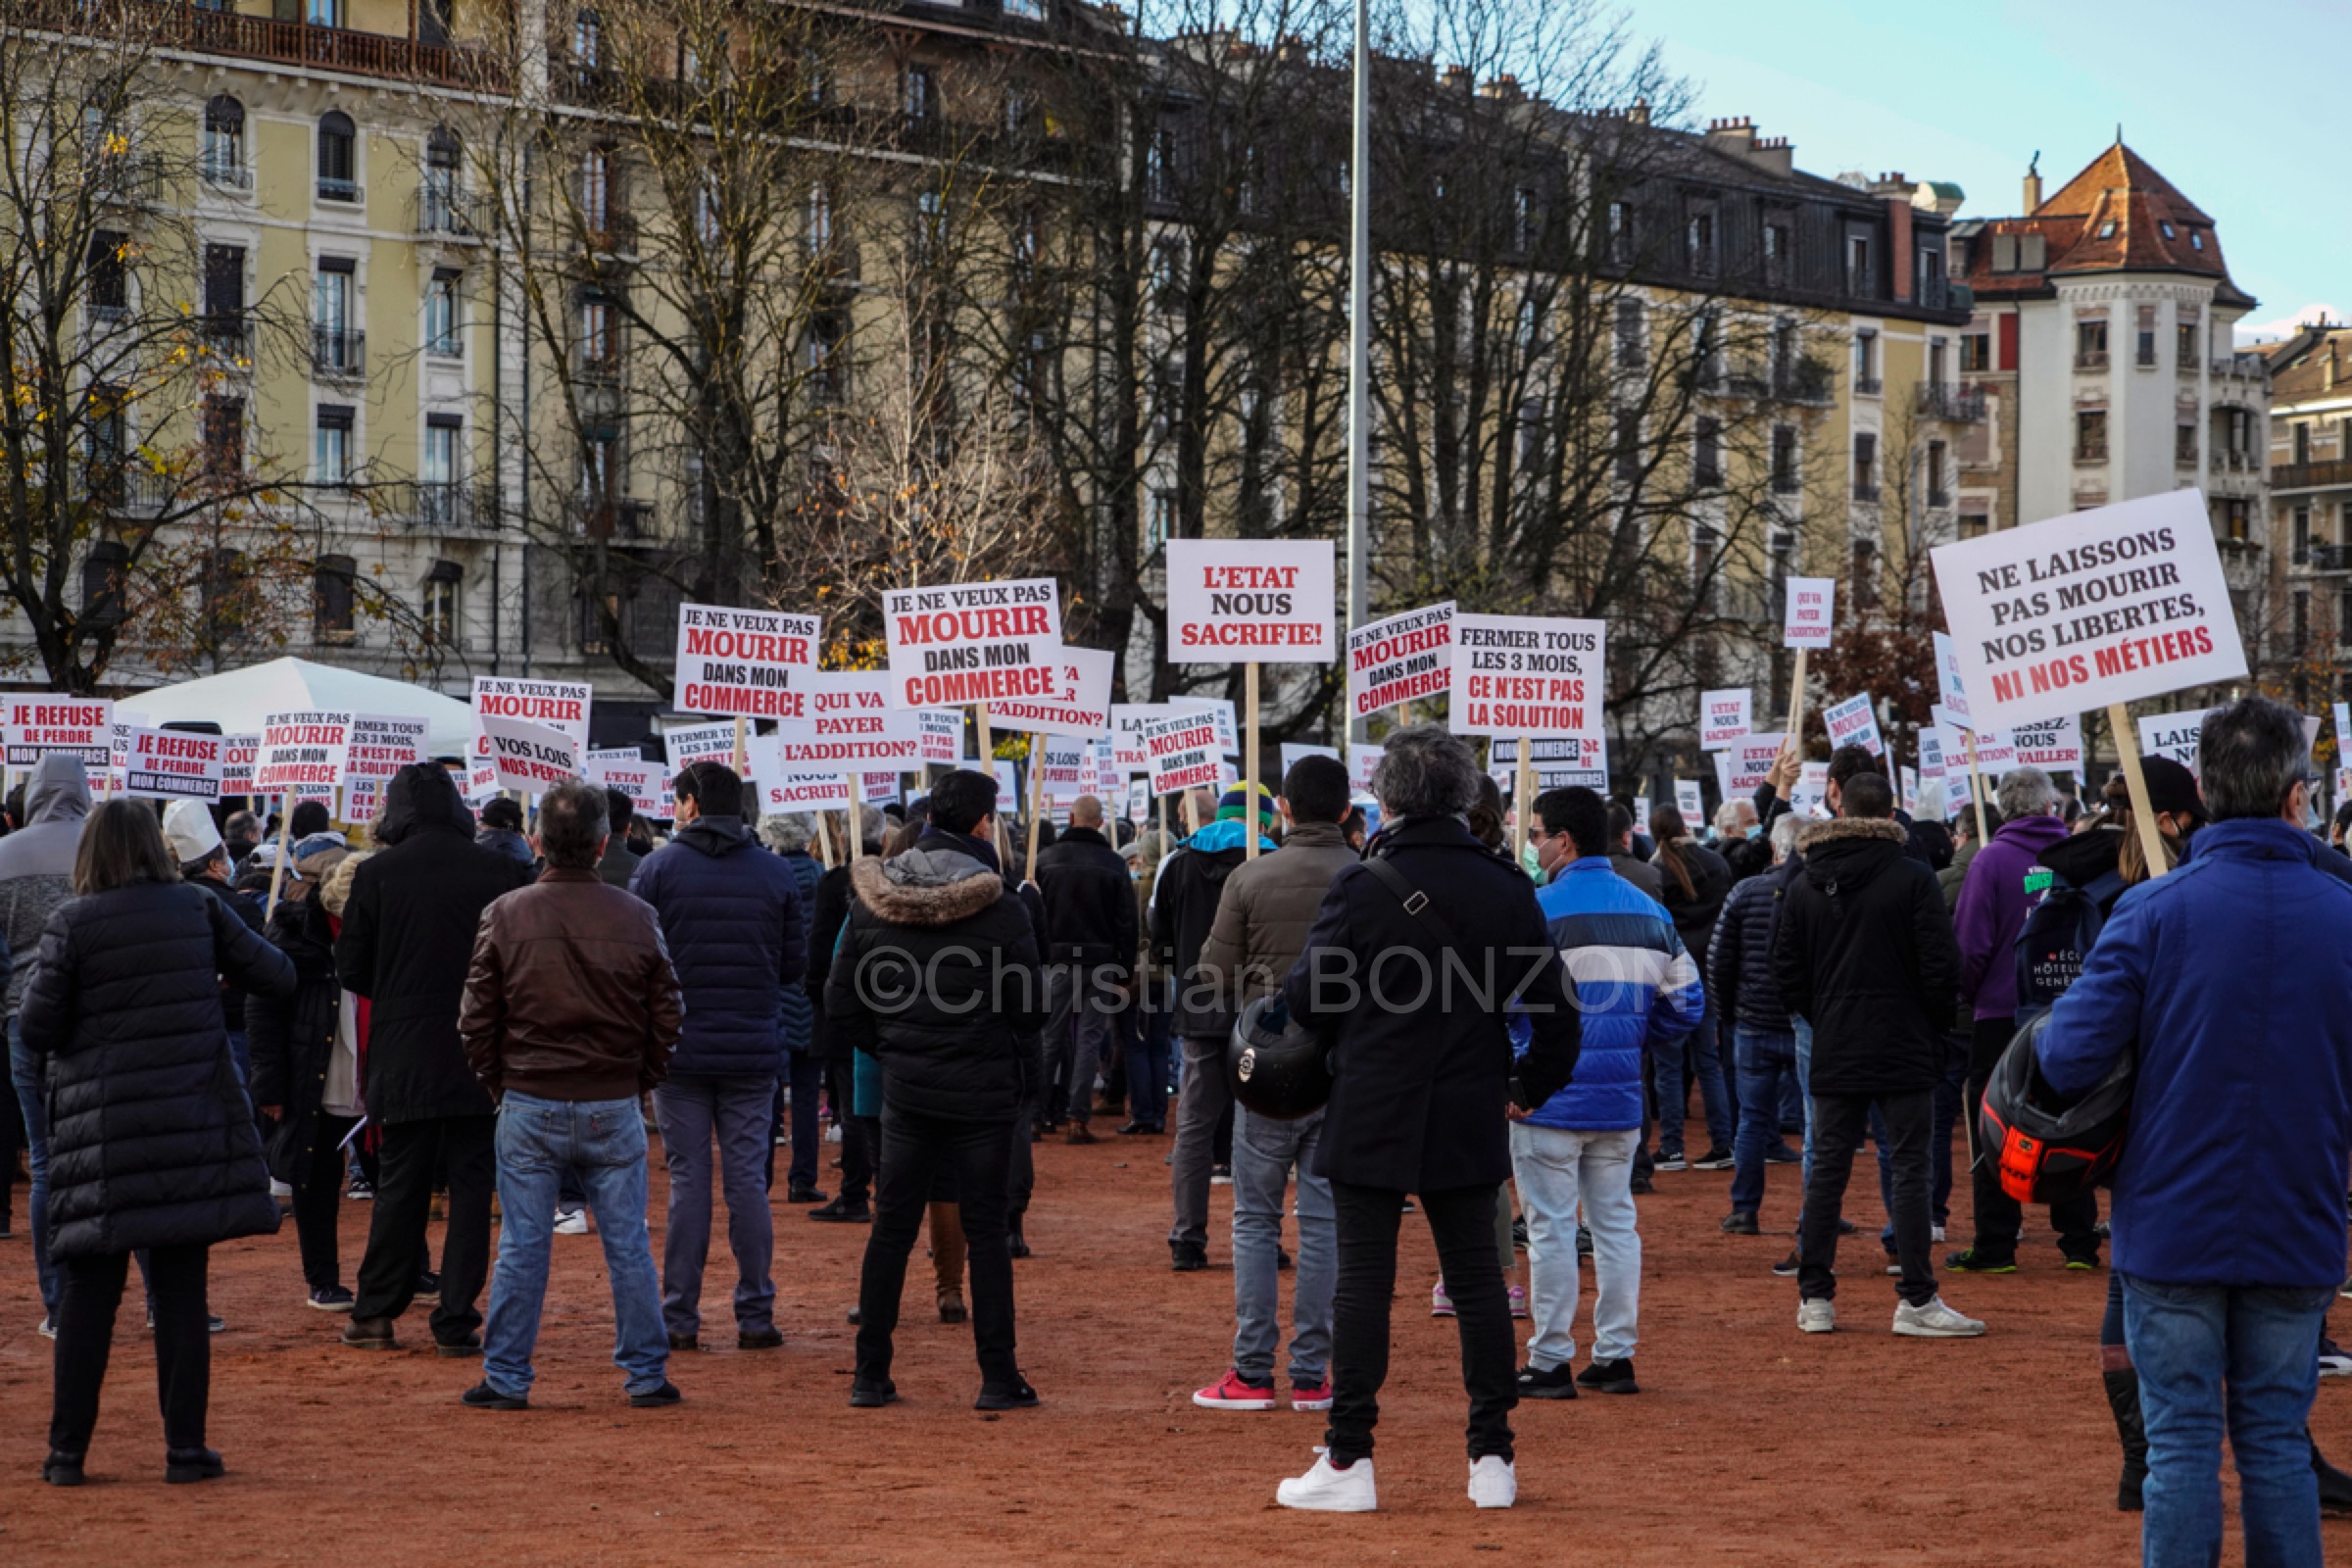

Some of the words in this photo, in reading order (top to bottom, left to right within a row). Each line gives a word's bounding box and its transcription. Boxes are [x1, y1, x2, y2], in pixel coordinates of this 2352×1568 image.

[1977, 564, 2021, 594] NE
[2026, 527, 2176, 582] LAISSONS
[1203, 566, 1299, 589] L'ETAT
[892, 595, 912, 613] JE
[917, 592, 947, 611] NE
[951, 587, 1009, 607] VEUX
[1012, 584, 1052, 603] PAS
[1211, 593, 1293, 615] NOUS
[1991, 593, 2049, 627] PAS
[2056, 562, 2180, 611] MOURIR
[684, 609, 702, 626] JE
[706, 612, 727, 627] NE
[732, 613, 779, 632] VEUX
[782, 619, 814, 635] PAS
[897, 605, 1052, 646] MOURIR
[1350, 636, 1363, 650] JE
[1366, 629, 1382, 645] NE
[1386, 617, 1424, 636] VEUX
[1427, 608, 1452, 625] PAS
[1982, 628, 2046, 664] NOS
[2052, 593, 2205, 648] LIBERTES,
[1181, 622, 1322, 646] SACRIFIE!
[1460, 627, 1540, 650] FERMER
[1544, 632, 1596, 652] TOUS
[685, 628, 808, 664] MOURIR
[924, 646, 979, 672] DANS
[983, 642, 1030, 668] MON
[1353, 622, 1451, 672] MOURIR
[703, 662, 746, 684] DANS
[751, 665, 788, 688] MON
[1369, 662, 1403, 687] DANS
[1406, 652, 1438, 673] MON
[1472, 651, 1506, 670] LES
[1510, 654, 1522, 671] 3
[1527, 654, 1583, 676] MOIS,
[1991, 670, 2025, 704] NI
[2029, 655, 2090, 695] NOS
[2094, 625, 2214, 679] MÉTIERS
[478, 680, 492, 692] JE
[496, 682, 514, 694] NE
[518, 684, 557, 697] VEUX
[560, 687, 586, 699] PAS
[906, 666, 1055, 706] COMMERCE
[1357, 665, 1450, 713] COMMERCE
[1468, 675, 1491, 698] CE
[1494, 676, 1545, 701] N'EST
[1549, 679, 1585, 702] PAS
[479, 694, 582, 720] MOURIR
[685, 683, 805, 717] COMMERCE
[814, 692, 851, 711] QUI
[856, 692, 885, 709] VA
[12, 705, 30, 726] JE
[35, 705, 105, 726] REFUSE
[327, 713, 351, 725] PAS
[815, 716, 884, 735] PAYER
[987, 701, 1103, 728] L'ADDITION?
[1468, 703, 1489, 726] LA
[1493, 704, 1583, 729] SOLUTION
[24, 729, 40, 743] DE
[43, 729, 93, 743] PERDRE
[265, 725, 346, 747] MOURIR
[354, 720, 389, 732] RMER
[392, 723, 423, 735] TOUS
[670, 730, 718, 745] FERMER
[720, 727, 751, 738] TOS
[2153, 727, 2200, 748] LAIS
[136, 734, 153, 754] JE
[157, 737, 219, 760] REFUSE
[370, 734, 377, 744] 3
[382, 735, 415, 747] MOIS,
[494, 736, 531, 758] VOS
[534, 743, 572, 768] LOIS
[680, 743, 700, 755] LES
[703, 742, 710, 752] 3
[785, 740, 917, 761] L'ADDITION?
[1149, 726, 1215, 757] MOURIR
[9, 748, 37, 763] MON
[271, 749, 298, 763] DANS
[300, 749, 327, 762] MON
[361, 747, 391, 760] N'EST
[393, 748, 416, 761] PAS
[1056, 752, 1081, 764] LOIS
[145, 758, 159, 770] DE
[162, 760, 205, 775] PERDRE
[223, 766, 251, 779] DANS
[259, 764, 337, 784] COMMERCE
[360, 760, 400, 775] SOLUTI
[472, 768, 495, 785] NOS
[498, 756, 529, 777] NOS
[530, 762, 574, 781] PERT
[604, 771, 647, 784] L'ETAT
[1155, 762, 1219, 792] COMMERCE
[88, 778, 122, 790] PERES
[130, 773, 154, 790] MON
[157, 776, 217, 795] COMMERCE
[2034, 962, 2082, 975] HÔTELI
[2035, 976, 2076, 987] GENÈ
